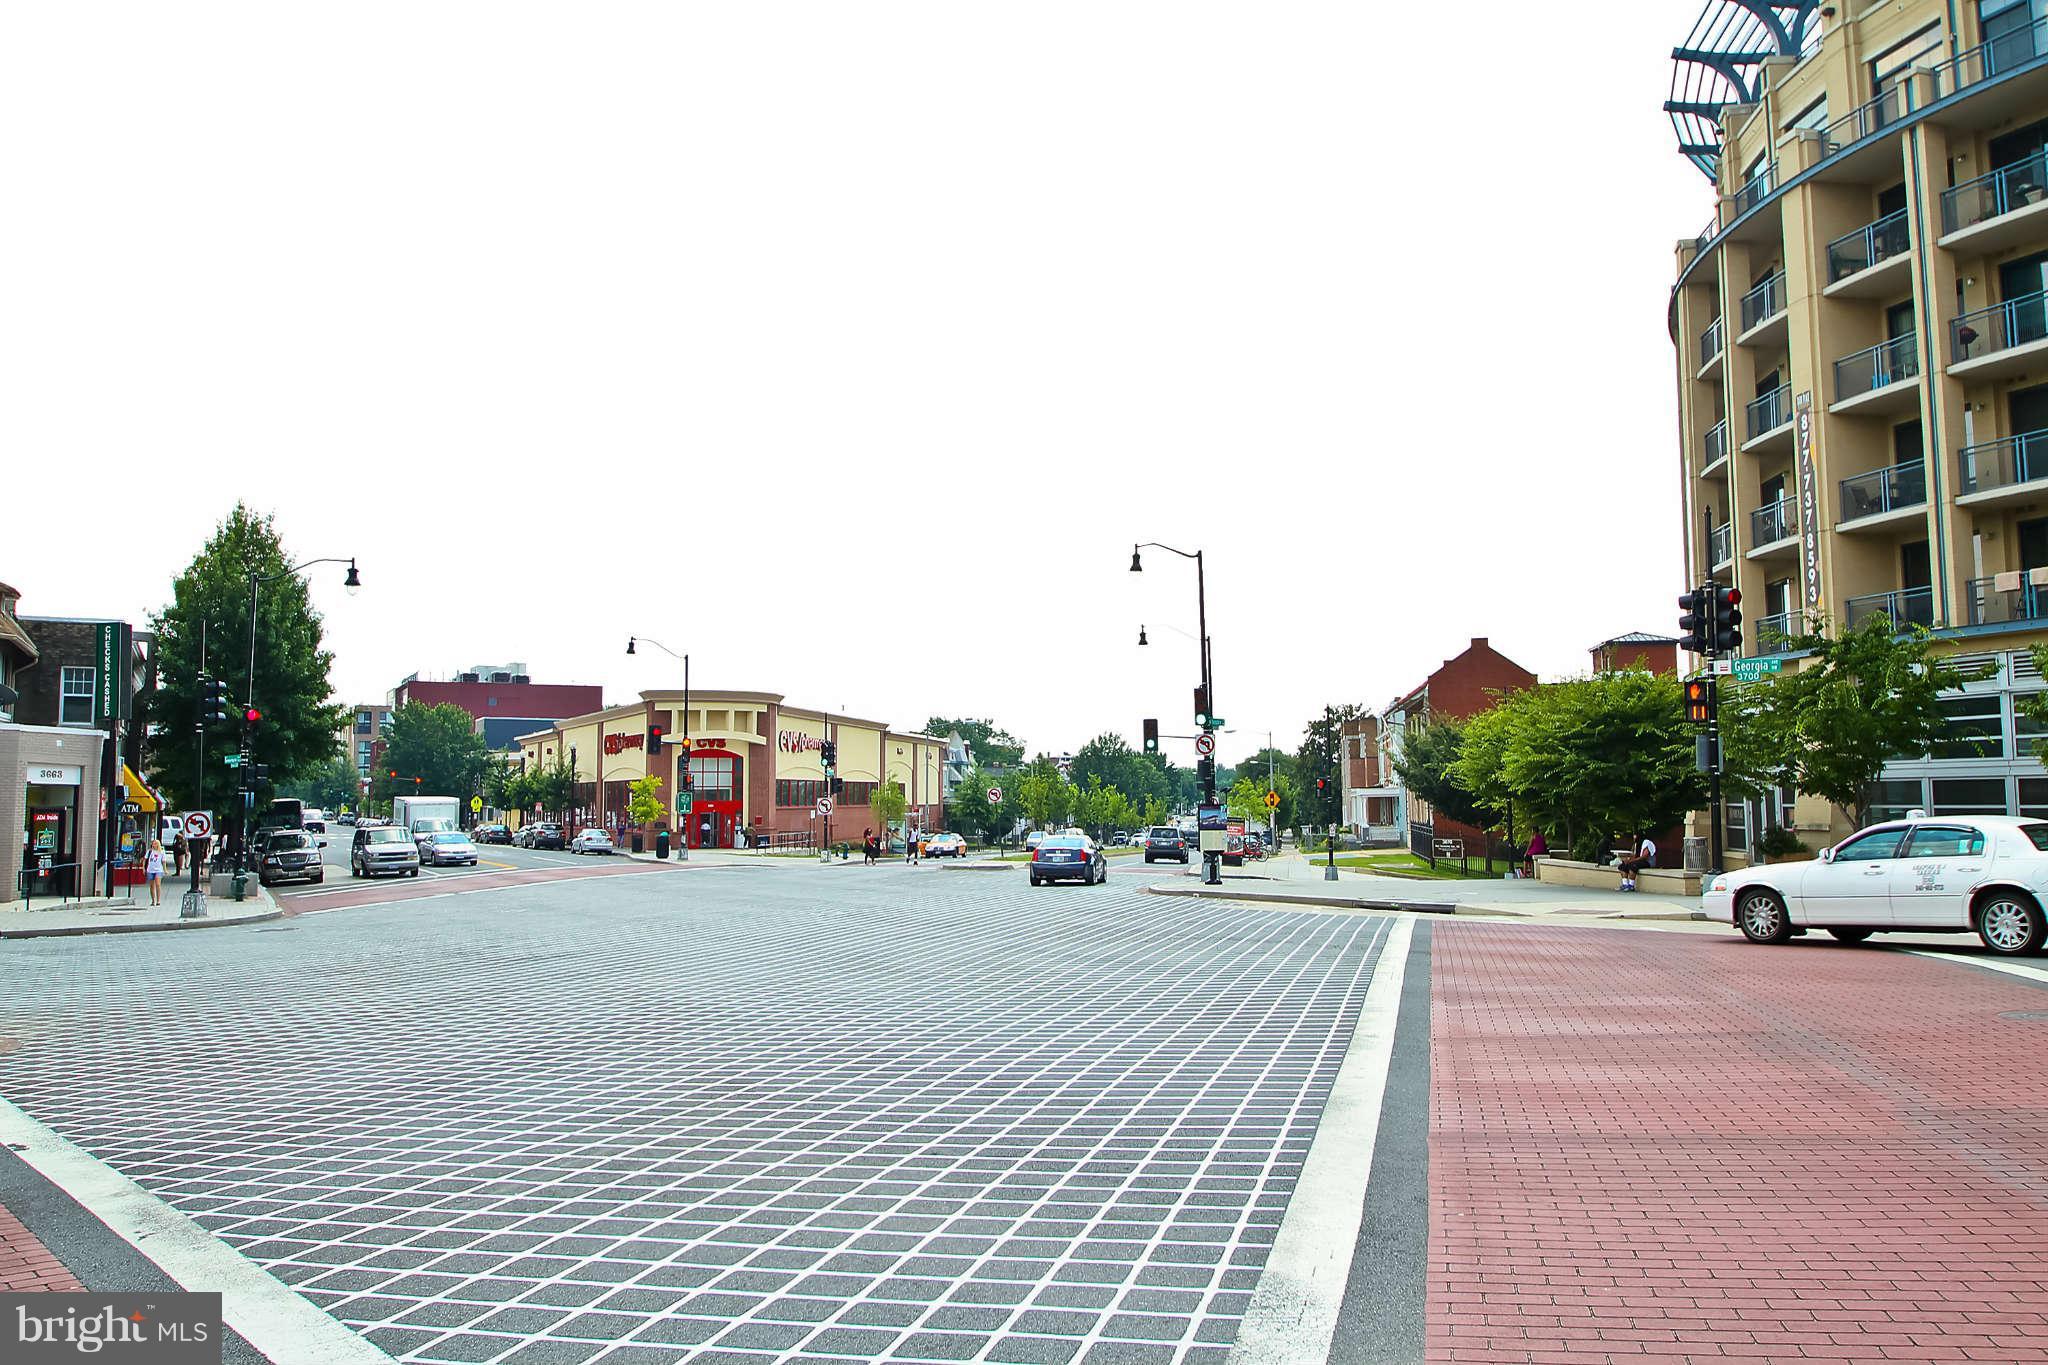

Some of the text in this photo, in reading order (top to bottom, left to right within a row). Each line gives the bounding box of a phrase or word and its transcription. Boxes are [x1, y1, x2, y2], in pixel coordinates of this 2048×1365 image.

[1734, 660, 1769, 673] Georgia
[1737, 672, 1759, 681] 3700
[696, 738, 727, 748] CVS
[40, 770, 62, 779] 3663
[120, 804, 139, 813] ATM
